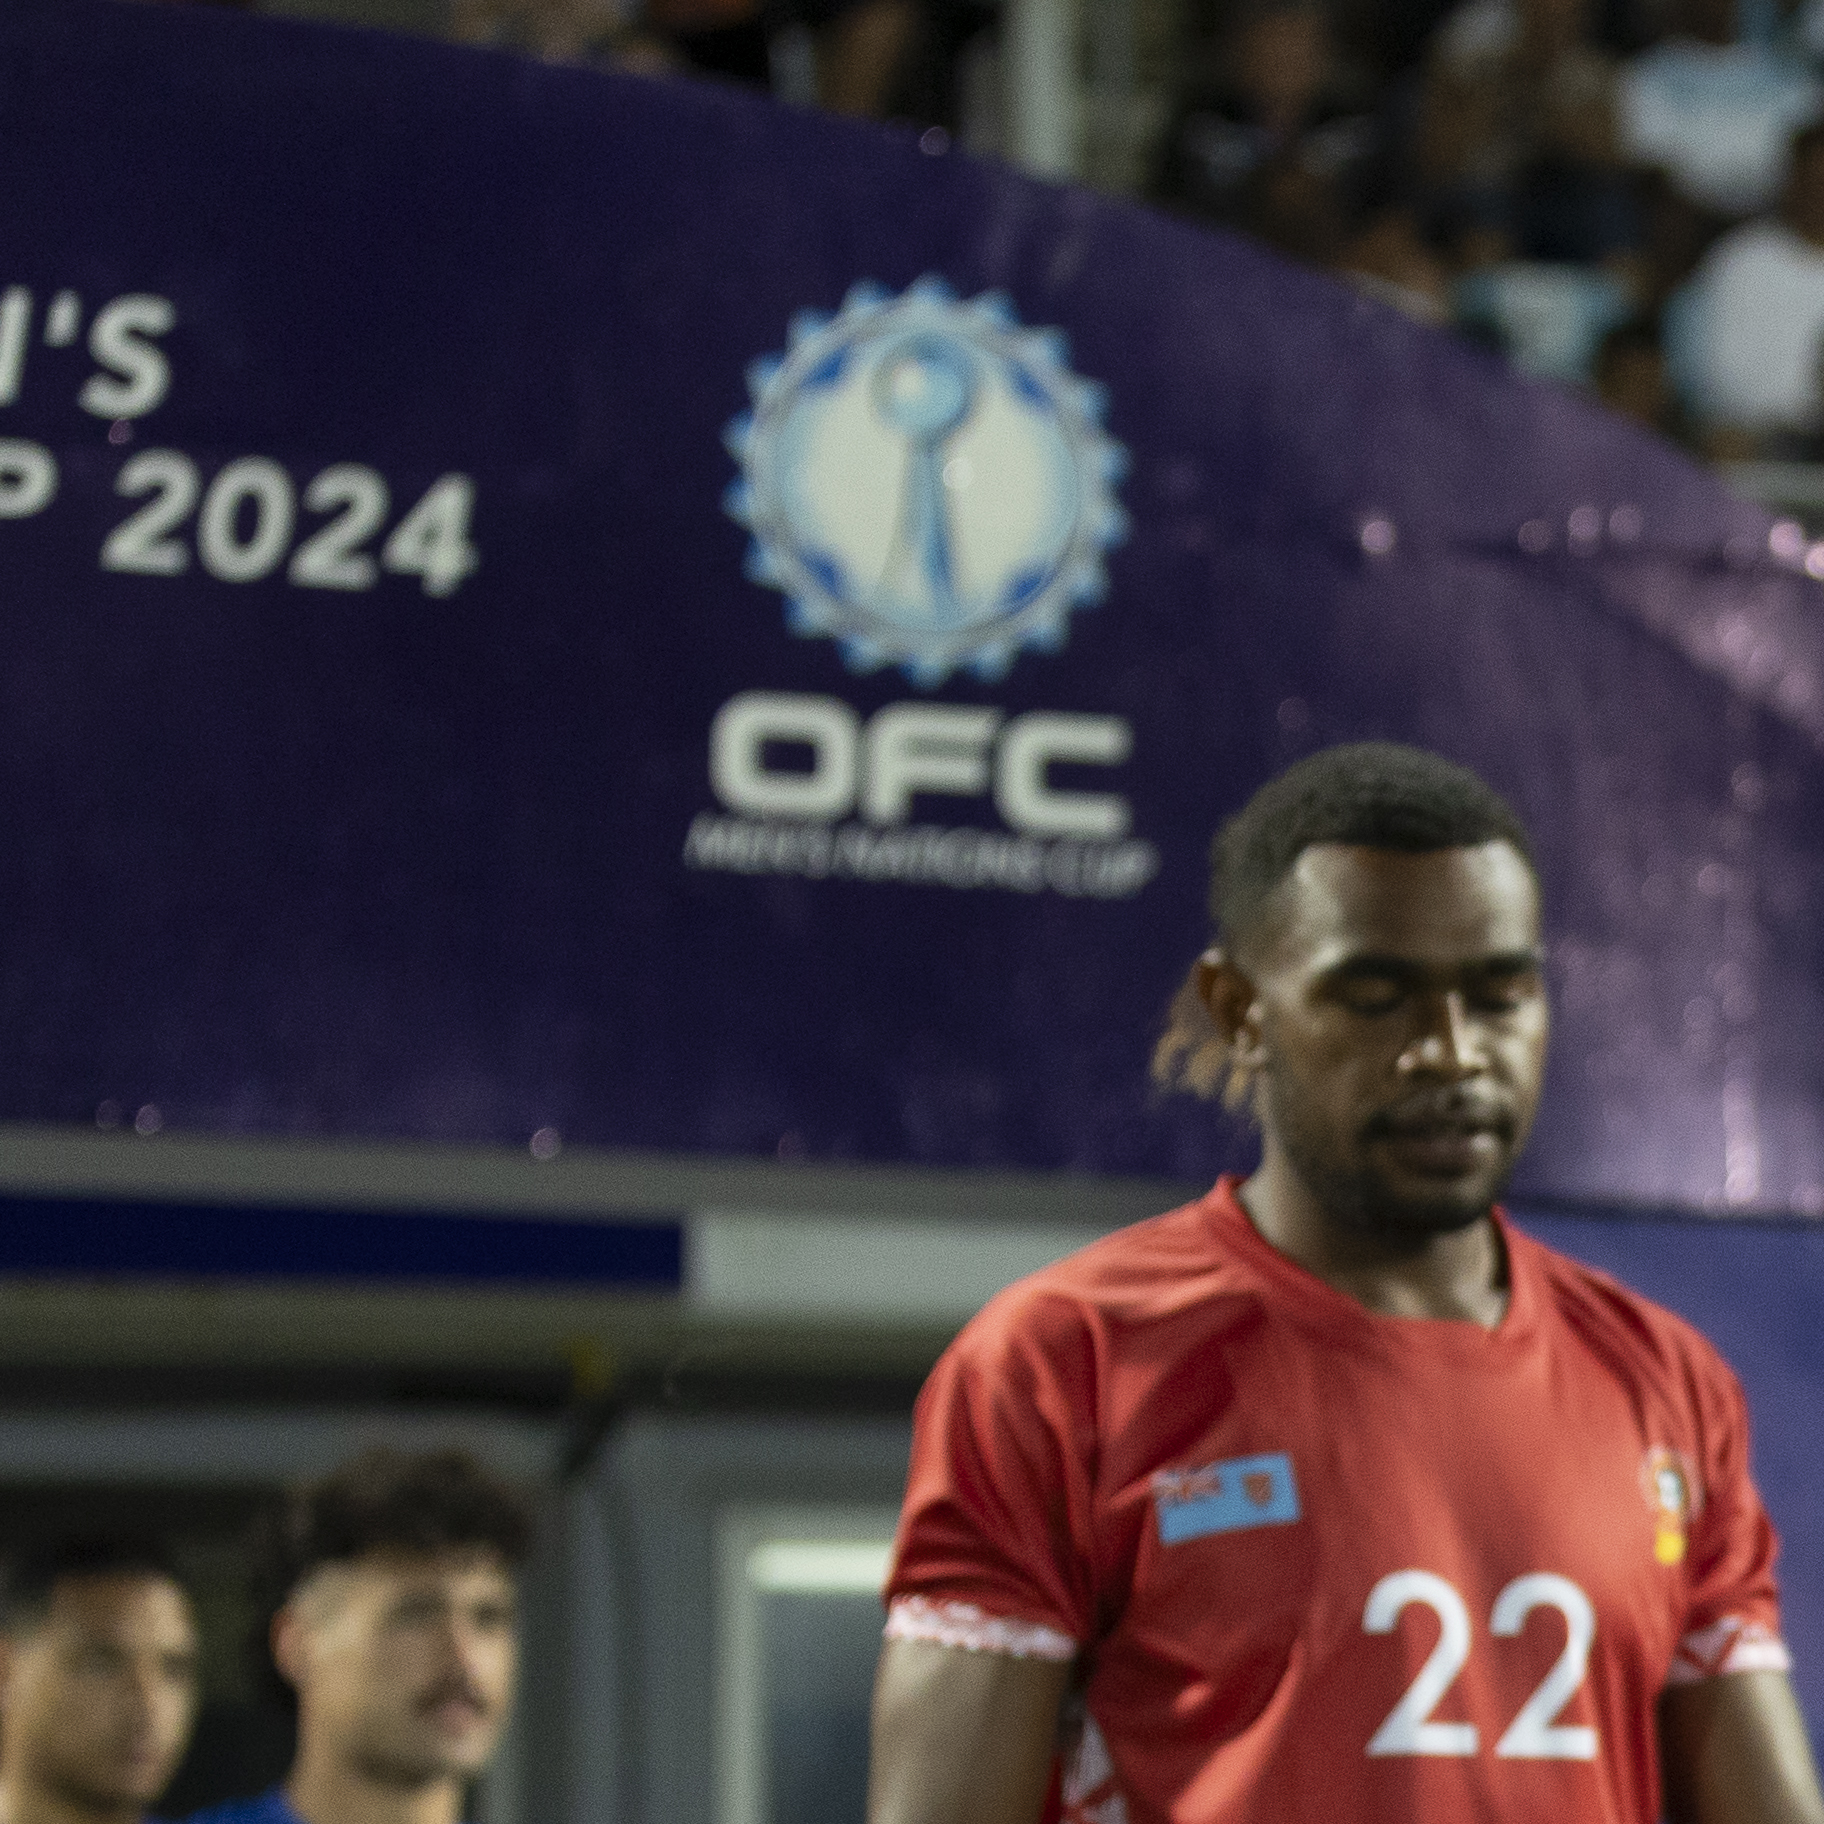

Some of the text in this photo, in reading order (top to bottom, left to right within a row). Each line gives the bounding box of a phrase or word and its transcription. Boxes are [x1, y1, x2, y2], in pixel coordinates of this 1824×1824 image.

[100, 446, 481, 600] 2024
[709, 687, 1135, 842] OFC
[1363, 1569, 1600, 1761] 22
